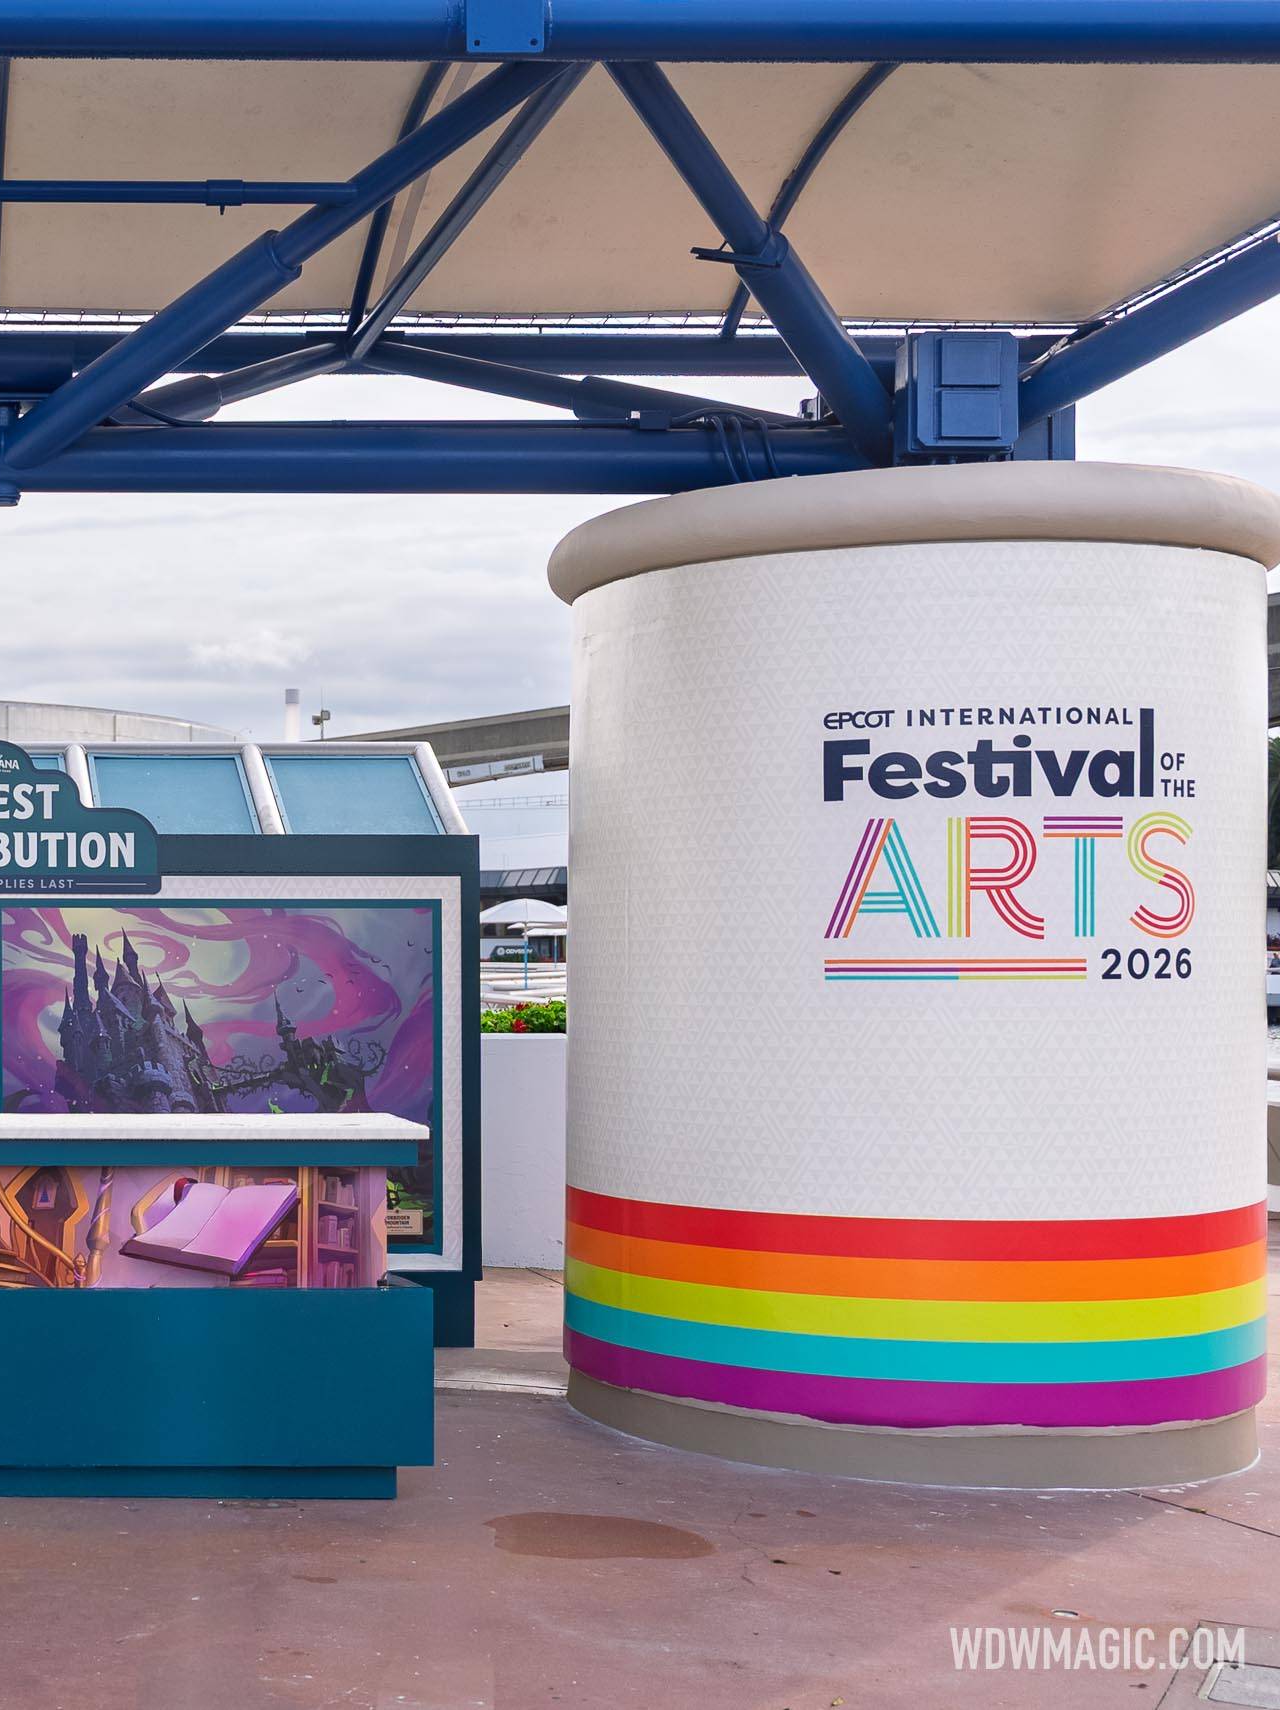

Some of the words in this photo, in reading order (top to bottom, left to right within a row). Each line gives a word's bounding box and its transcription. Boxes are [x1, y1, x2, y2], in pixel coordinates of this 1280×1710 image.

[823, 709, 896, 730] EPCOT
[907, 707, 1134, 727] INTERNATIONAL
[823, 708, 1154, 802] Festival
[1160, 753, 1186, 771] OF
[1161, 779, 1195, 798] THE
[40, 879, 75, 889] LAST
[824, 811, 1195, 940] ARTS
[1101, 948, 1192, 981] 2026
